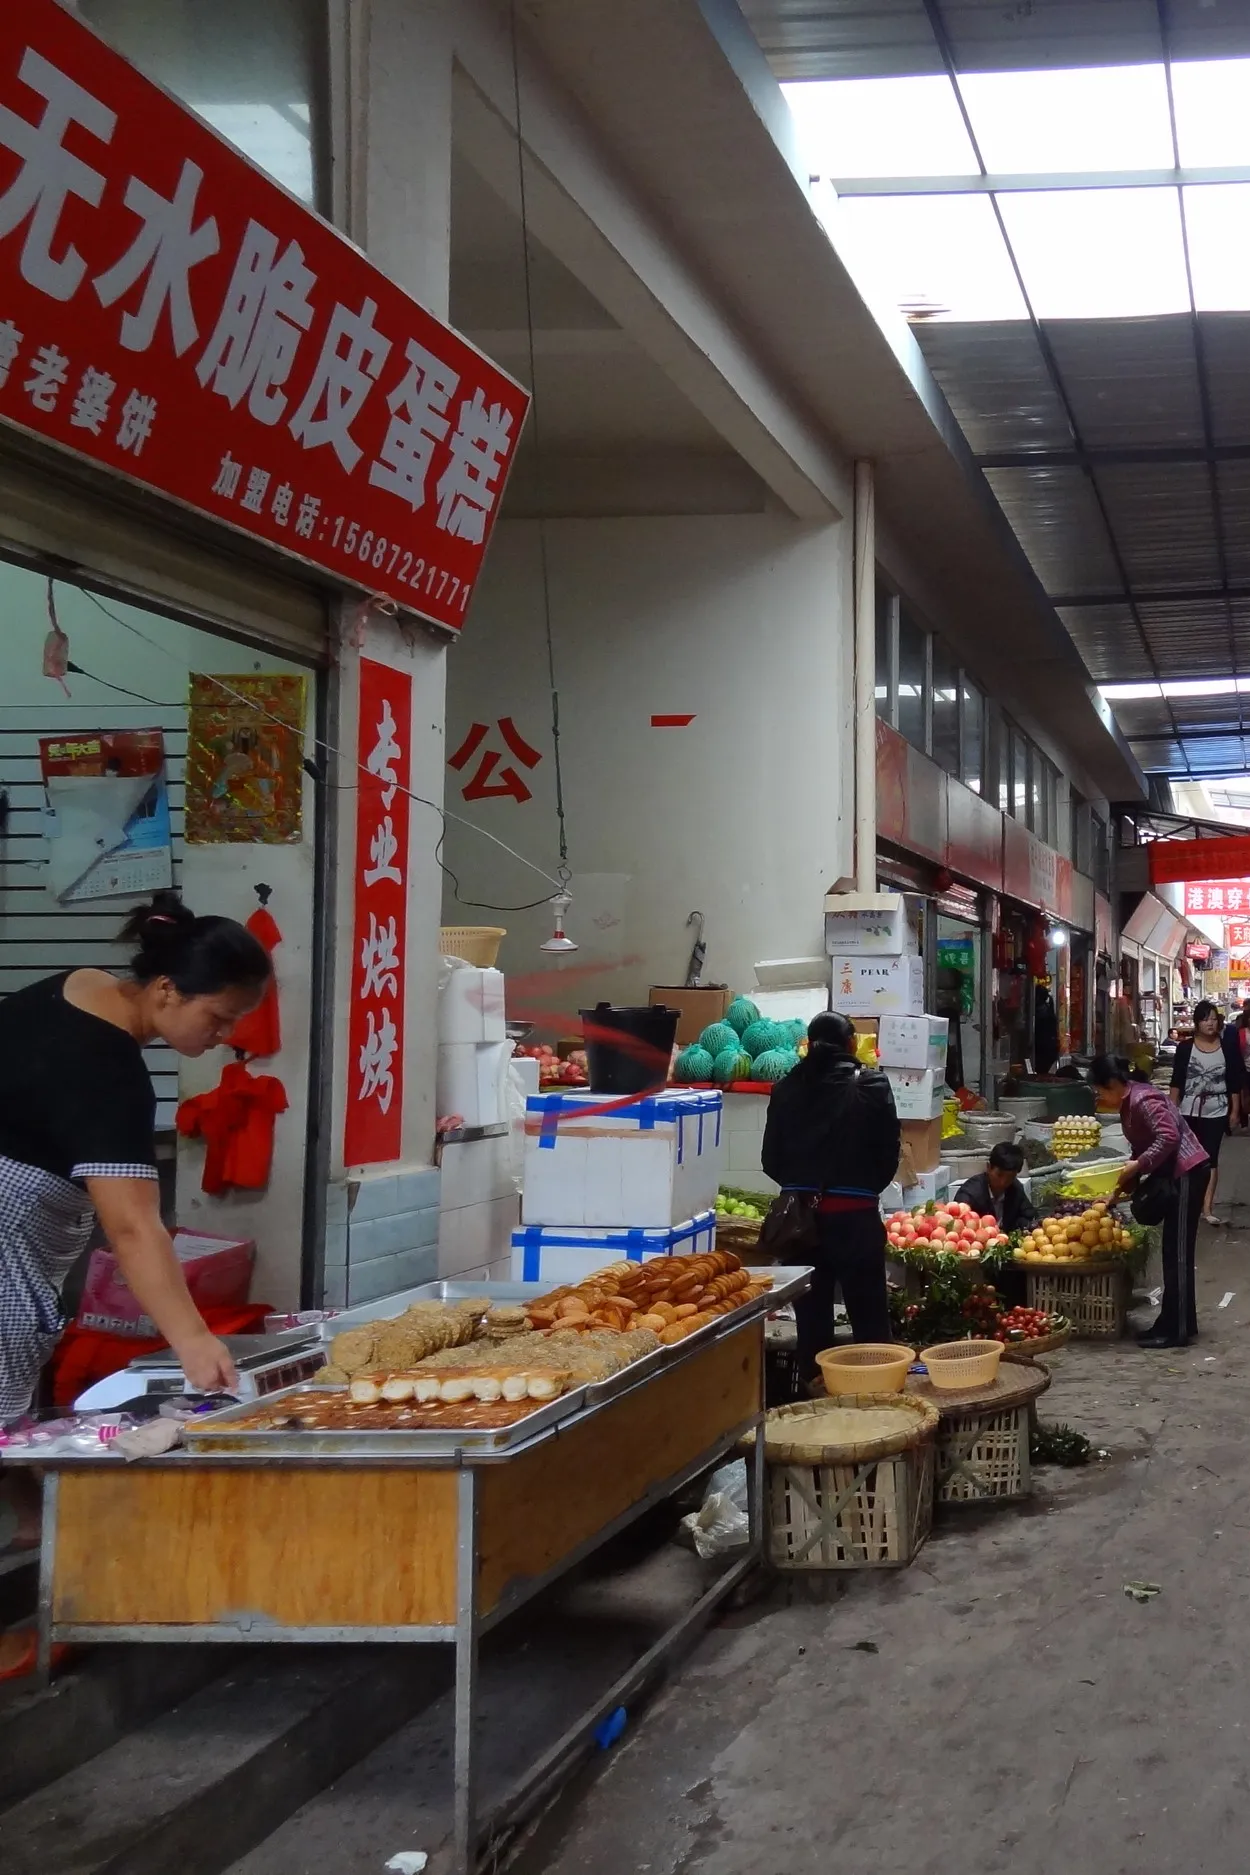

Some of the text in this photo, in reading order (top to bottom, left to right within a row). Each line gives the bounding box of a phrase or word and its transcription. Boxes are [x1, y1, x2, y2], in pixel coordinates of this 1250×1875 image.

[0, 46, 515, 546] 无水脆皮蛋糕
[212, 450, 471, 613] 加盟电话:15687221771
[447, 716, 542, 803] 公
[358, 698, 402, 1114] 专业烘烤
